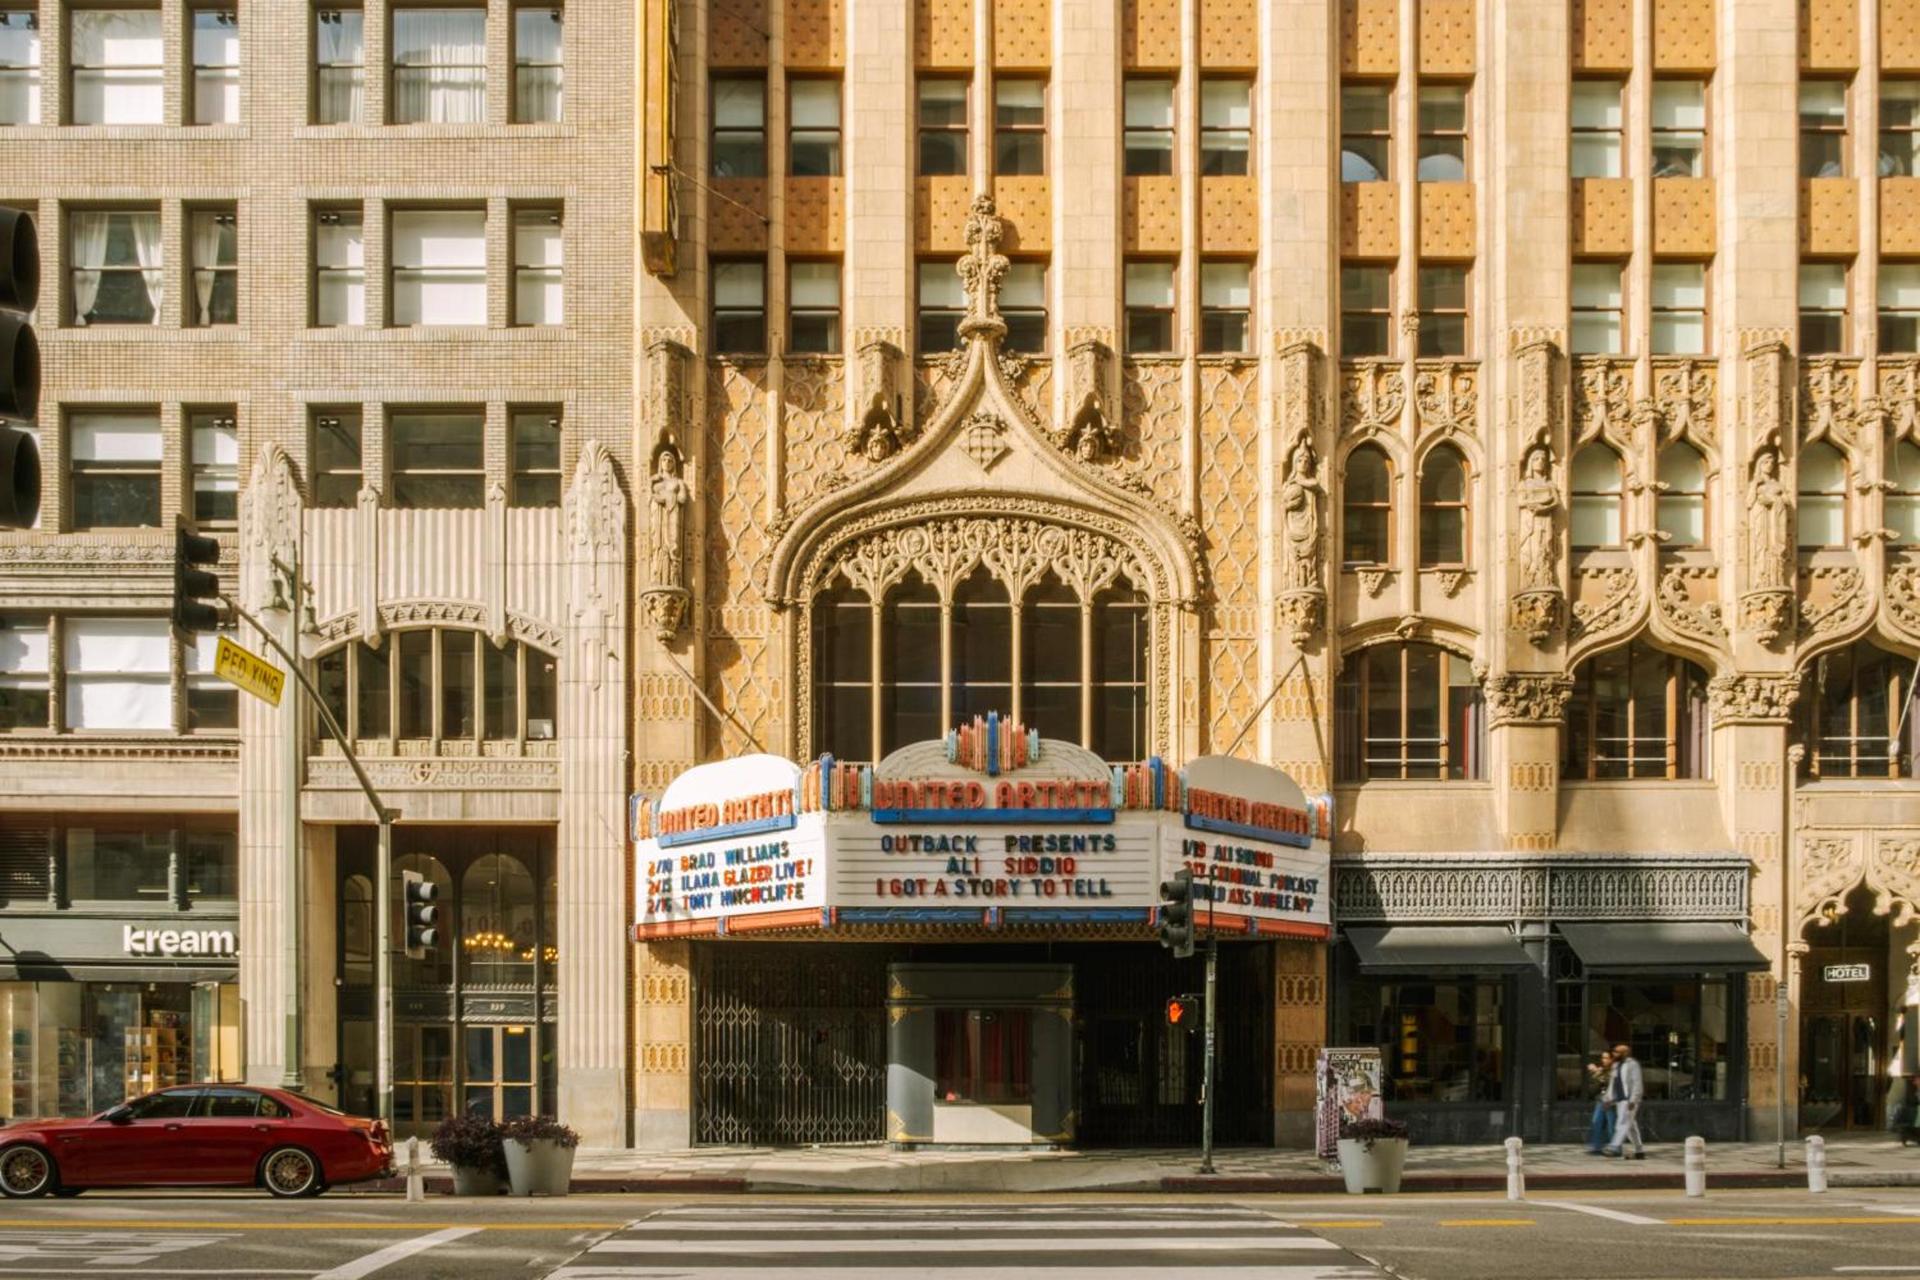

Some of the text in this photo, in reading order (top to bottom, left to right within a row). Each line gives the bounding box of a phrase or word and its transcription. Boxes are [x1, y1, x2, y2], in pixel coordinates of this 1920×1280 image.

[221, 646, 279, 696] PED XING
[873, 779, 1111, 810] UNITED ARTISTS
[659, 788, 794, 835] UNITED ARTISTS
[881, 834, 1116, 853] OUTBACK PRESENTS
[681, 852, 715, 872] BRAD
[724, 841, 789, 865] WILLIAMS
[946, 856, 980, 875] ALI
[681, 871, 719, 891] ILANA
[724, 865, 772, 887] GLAZER
[776, 859, 812, 880] LIVE!
[1270, 873, 1319, 894] PODCAST
[876, 878, 1112, 897] I GOT A STORY TO TELL
[683, 891, 713, 911] TONY
[1827, 967, 1866, 978] HOTEL
